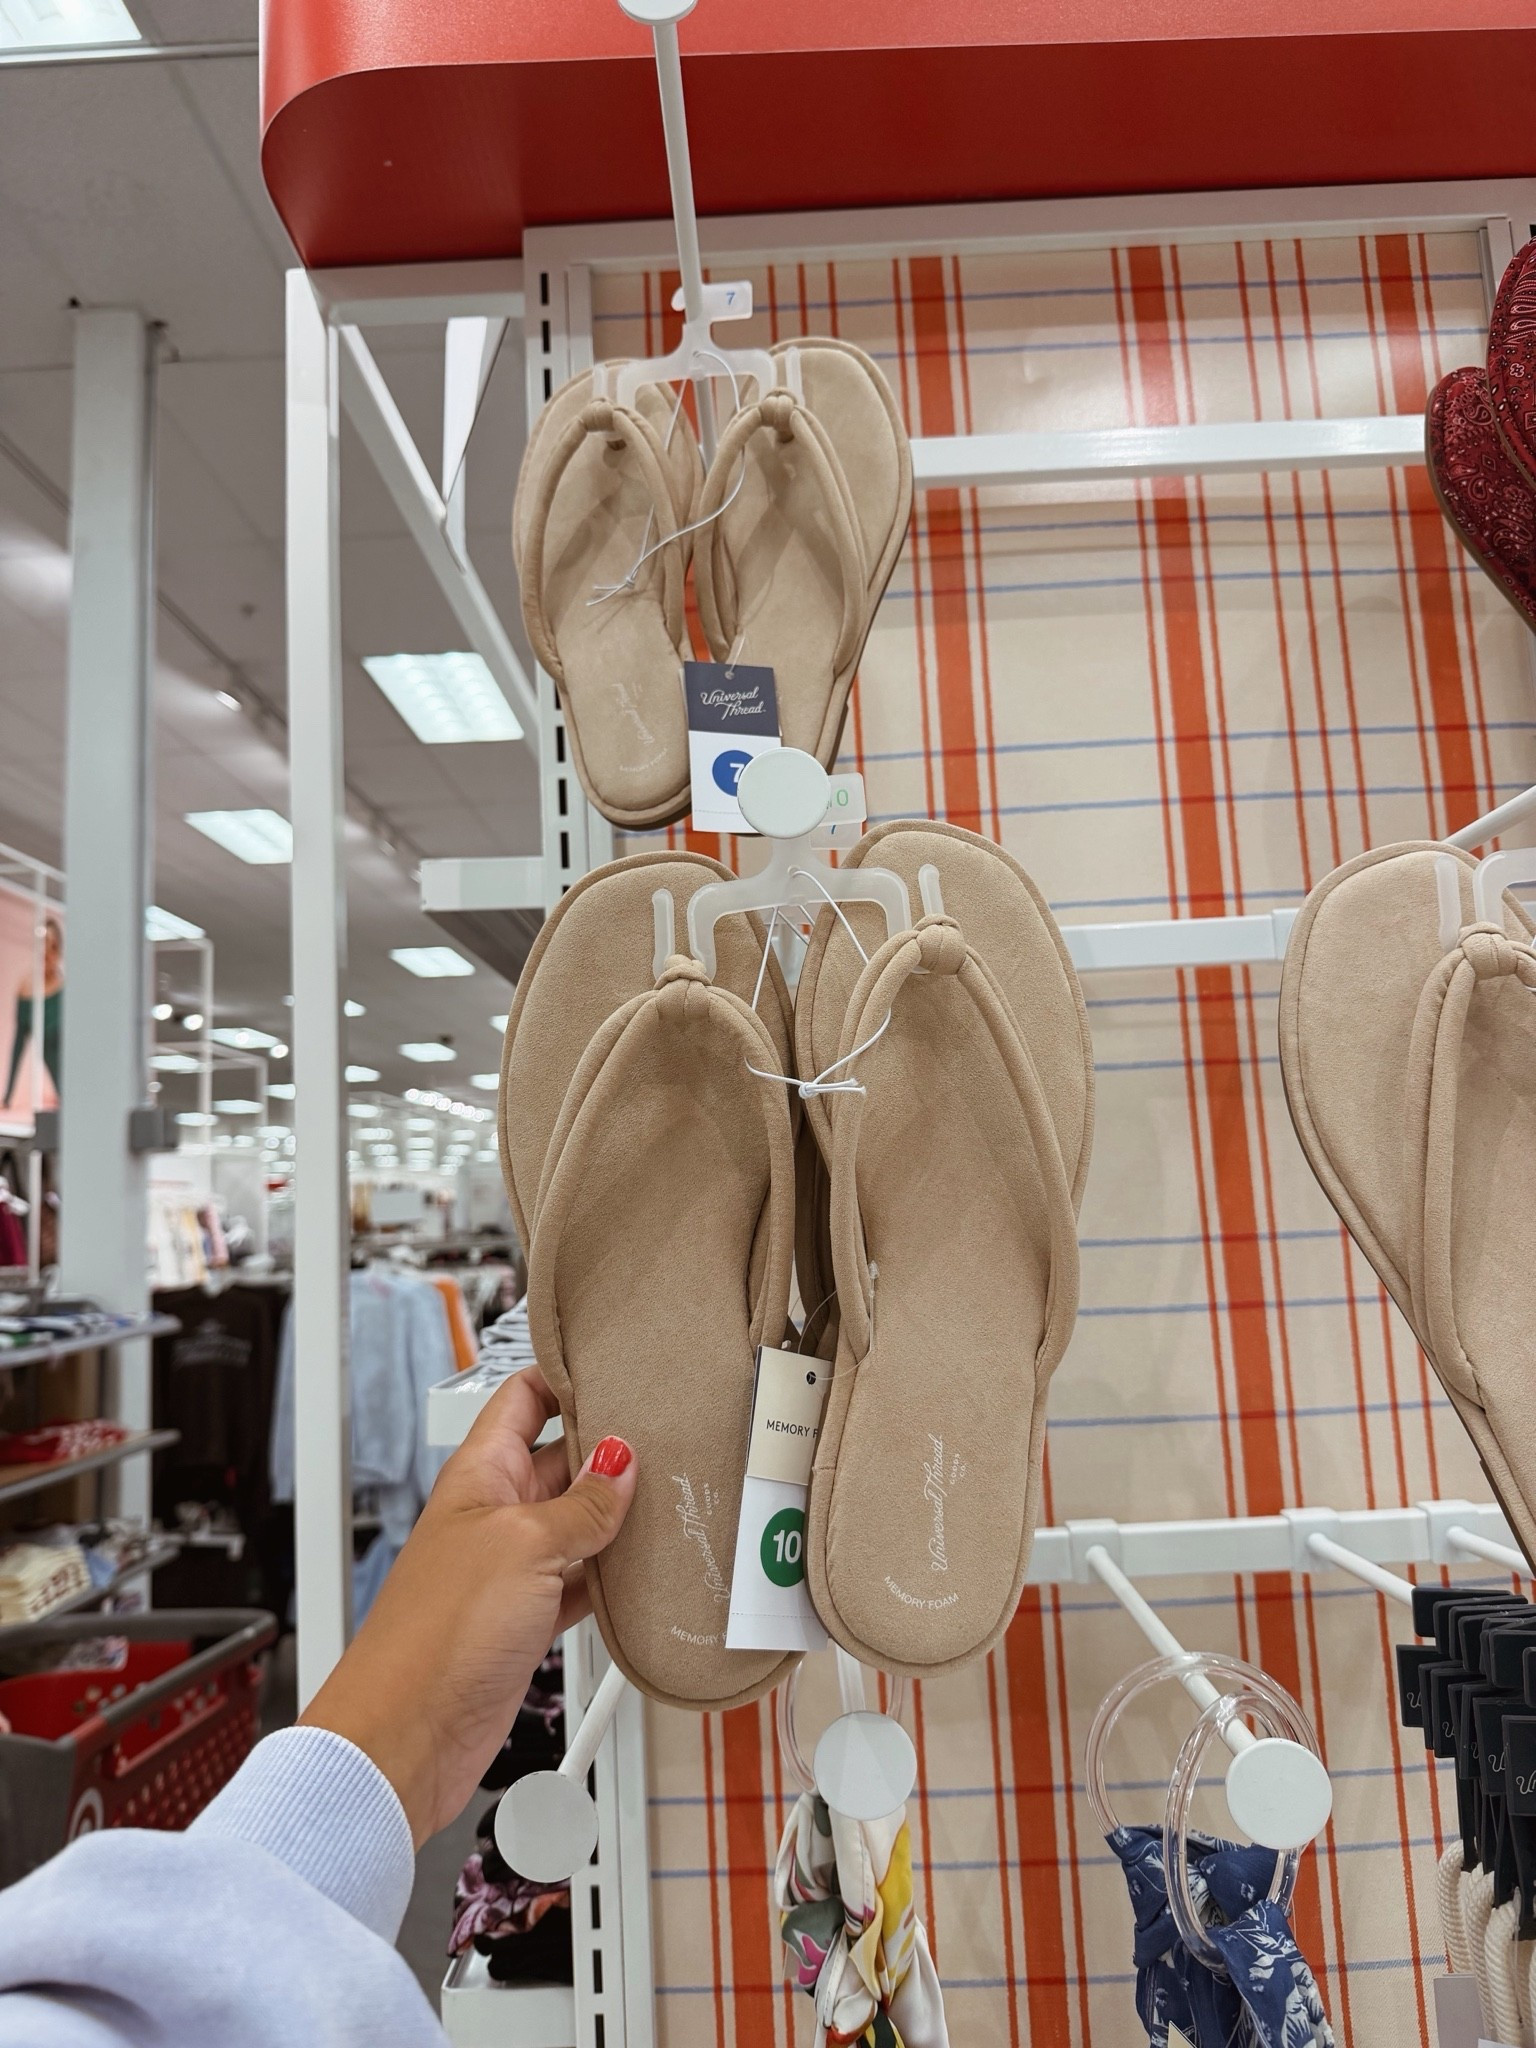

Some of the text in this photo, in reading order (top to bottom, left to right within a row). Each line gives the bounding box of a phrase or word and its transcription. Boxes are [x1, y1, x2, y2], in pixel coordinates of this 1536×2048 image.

[726, 291, 735, 305] 7
[700, 686, 759, 705] Universal
[729, 762, 745, 783] 7
[766, 1419, 810, 1437] MEMORY
[926, 1488, 948, 1571] Universal
[773, 1529, 802, 1564] 10
[687, 1528, 730, 1603] Universal
[884, 1575, 959, 1609] MEMORY FOAM
[670, 1625, 719, 1646] MEMORY
